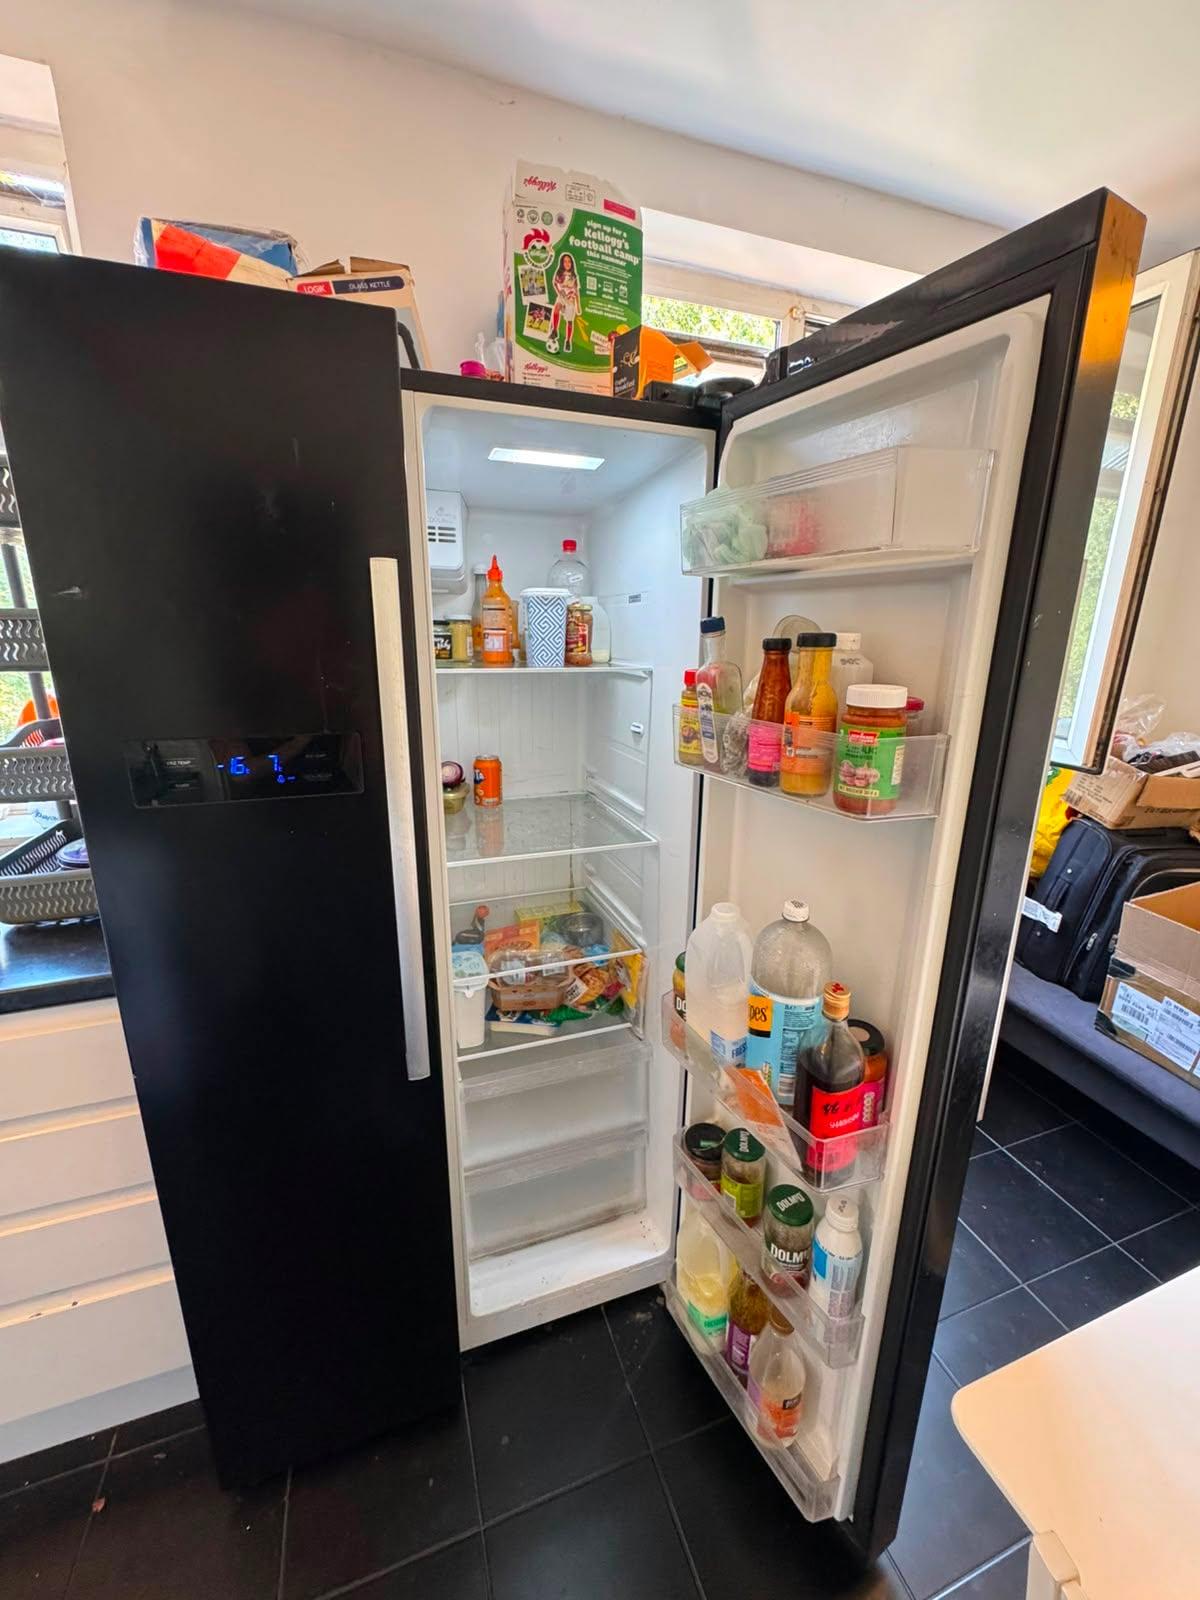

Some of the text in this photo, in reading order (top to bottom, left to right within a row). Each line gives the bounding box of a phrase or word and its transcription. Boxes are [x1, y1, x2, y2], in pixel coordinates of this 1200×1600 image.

[569, 235, 612, 255] football
[584, 227, 629, 250] Kellogg's
[348, 280, 391, 291] GLASS KETTLE
